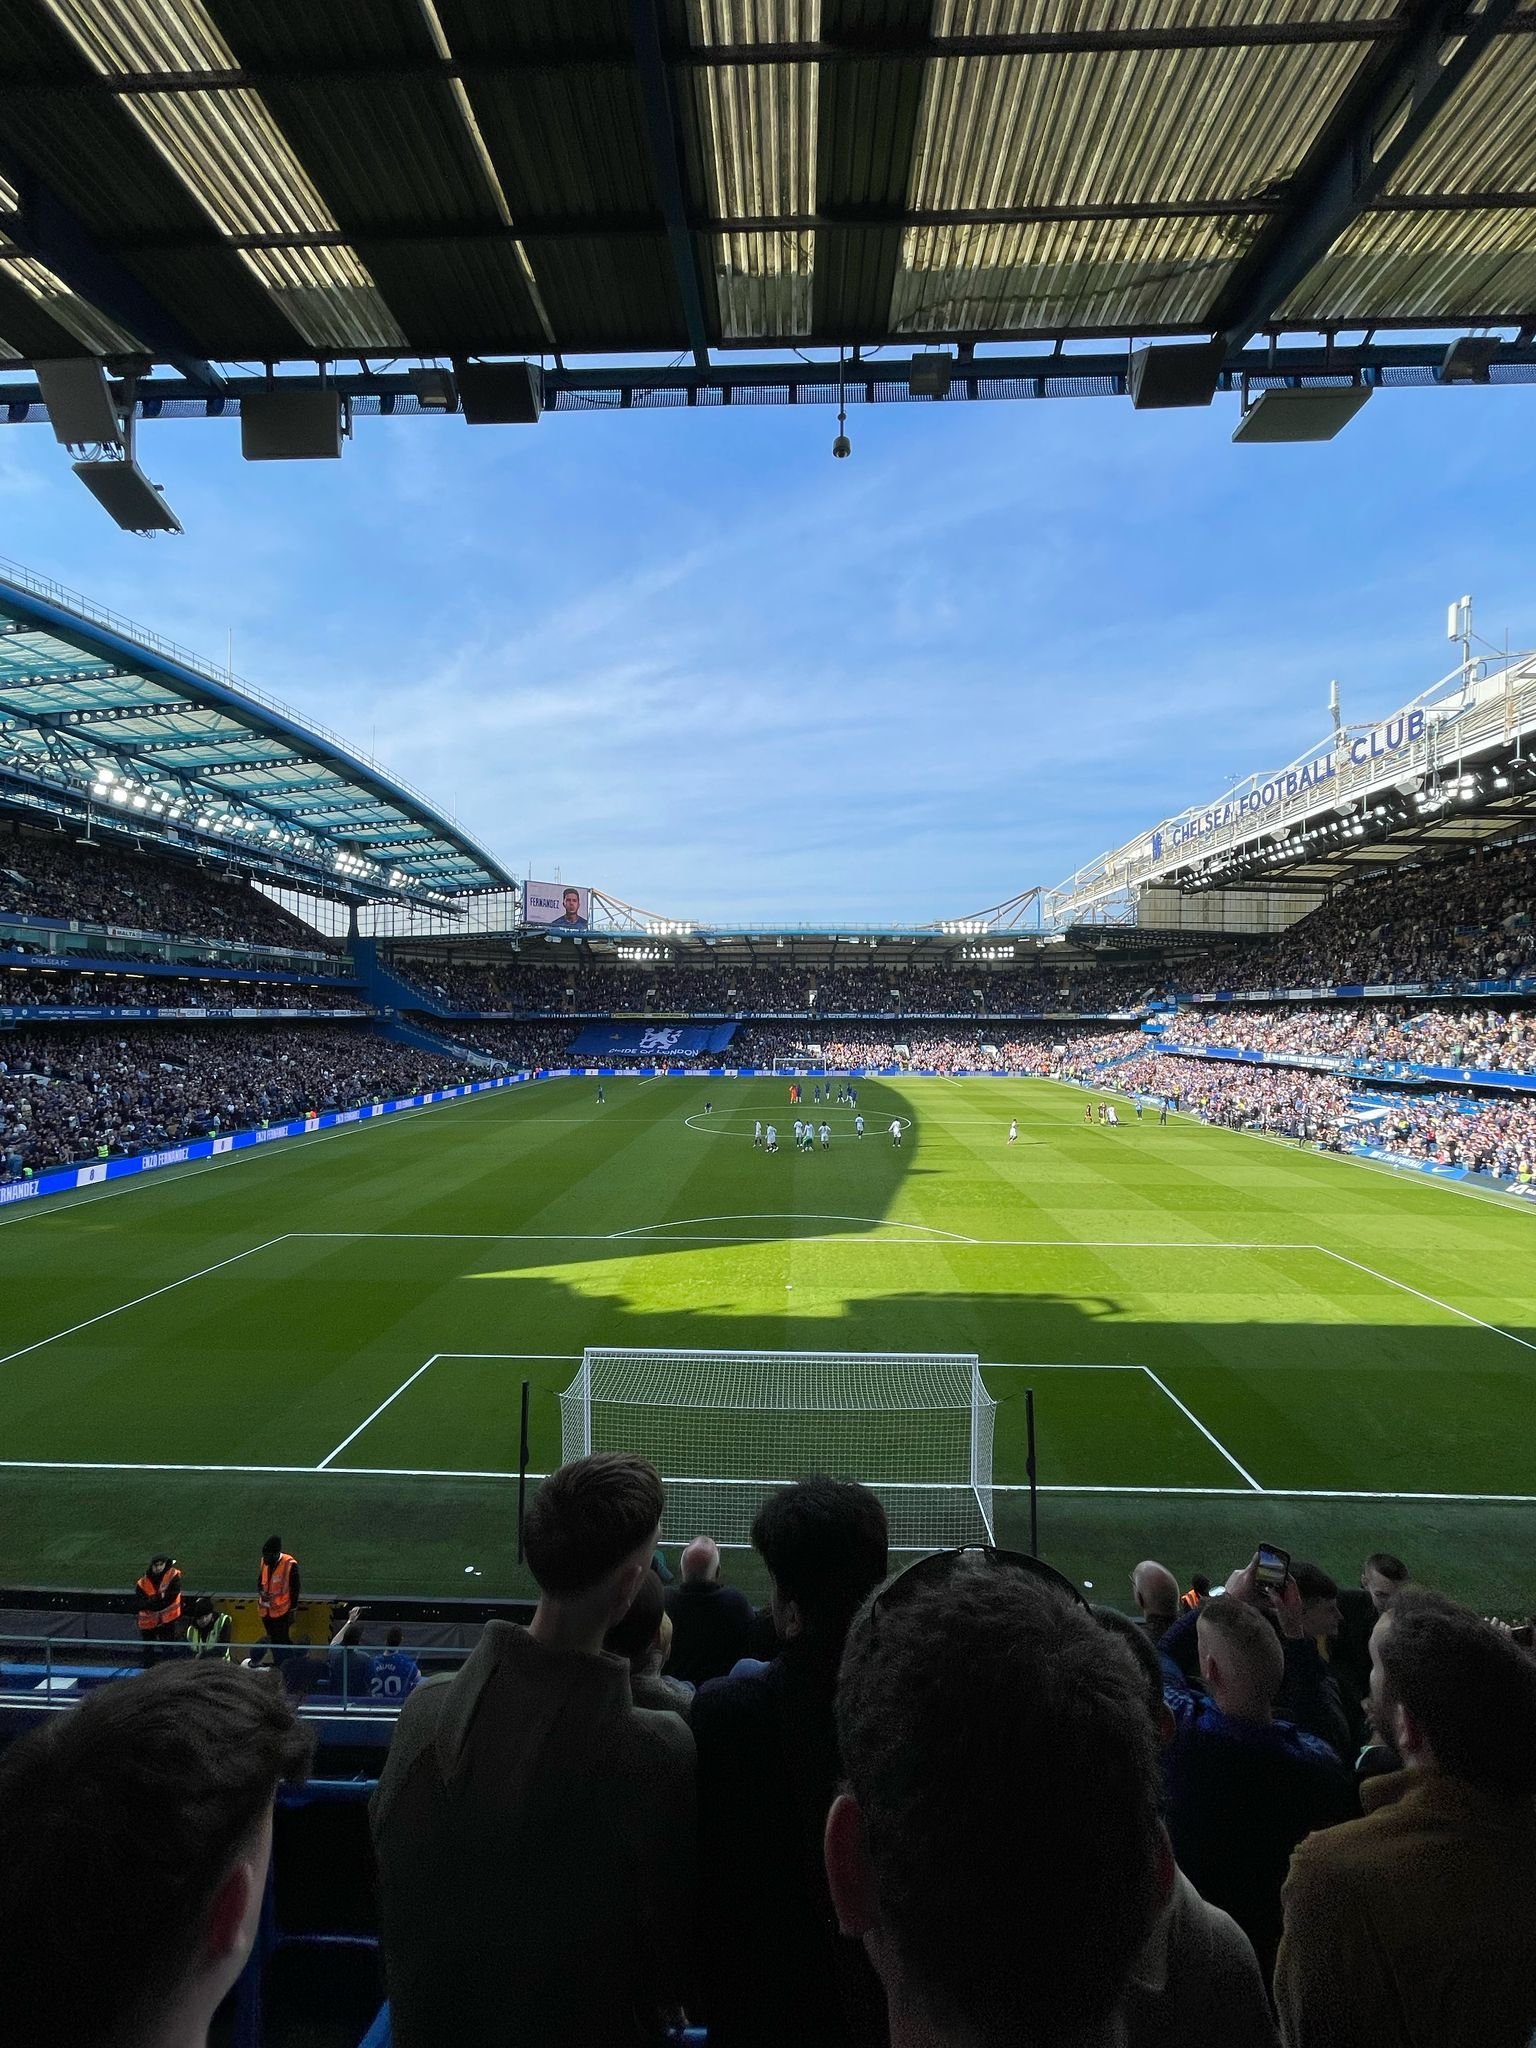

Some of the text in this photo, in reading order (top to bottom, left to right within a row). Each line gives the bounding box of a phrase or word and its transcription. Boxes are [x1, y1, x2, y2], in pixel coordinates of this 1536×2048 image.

[1173, 709, 1424, 848] CHELSEA FOOTBALL CLUB
[530, 897, 560, 909] FERNANDEZ
[31, 957, 60, 966] CHELSEA
[142, 1147, 189, 1170] ENZO FERNANDEZ
[0, 1180, 40, 1203] RNANDEZ
[371, 1676, 402, 1698] 20
